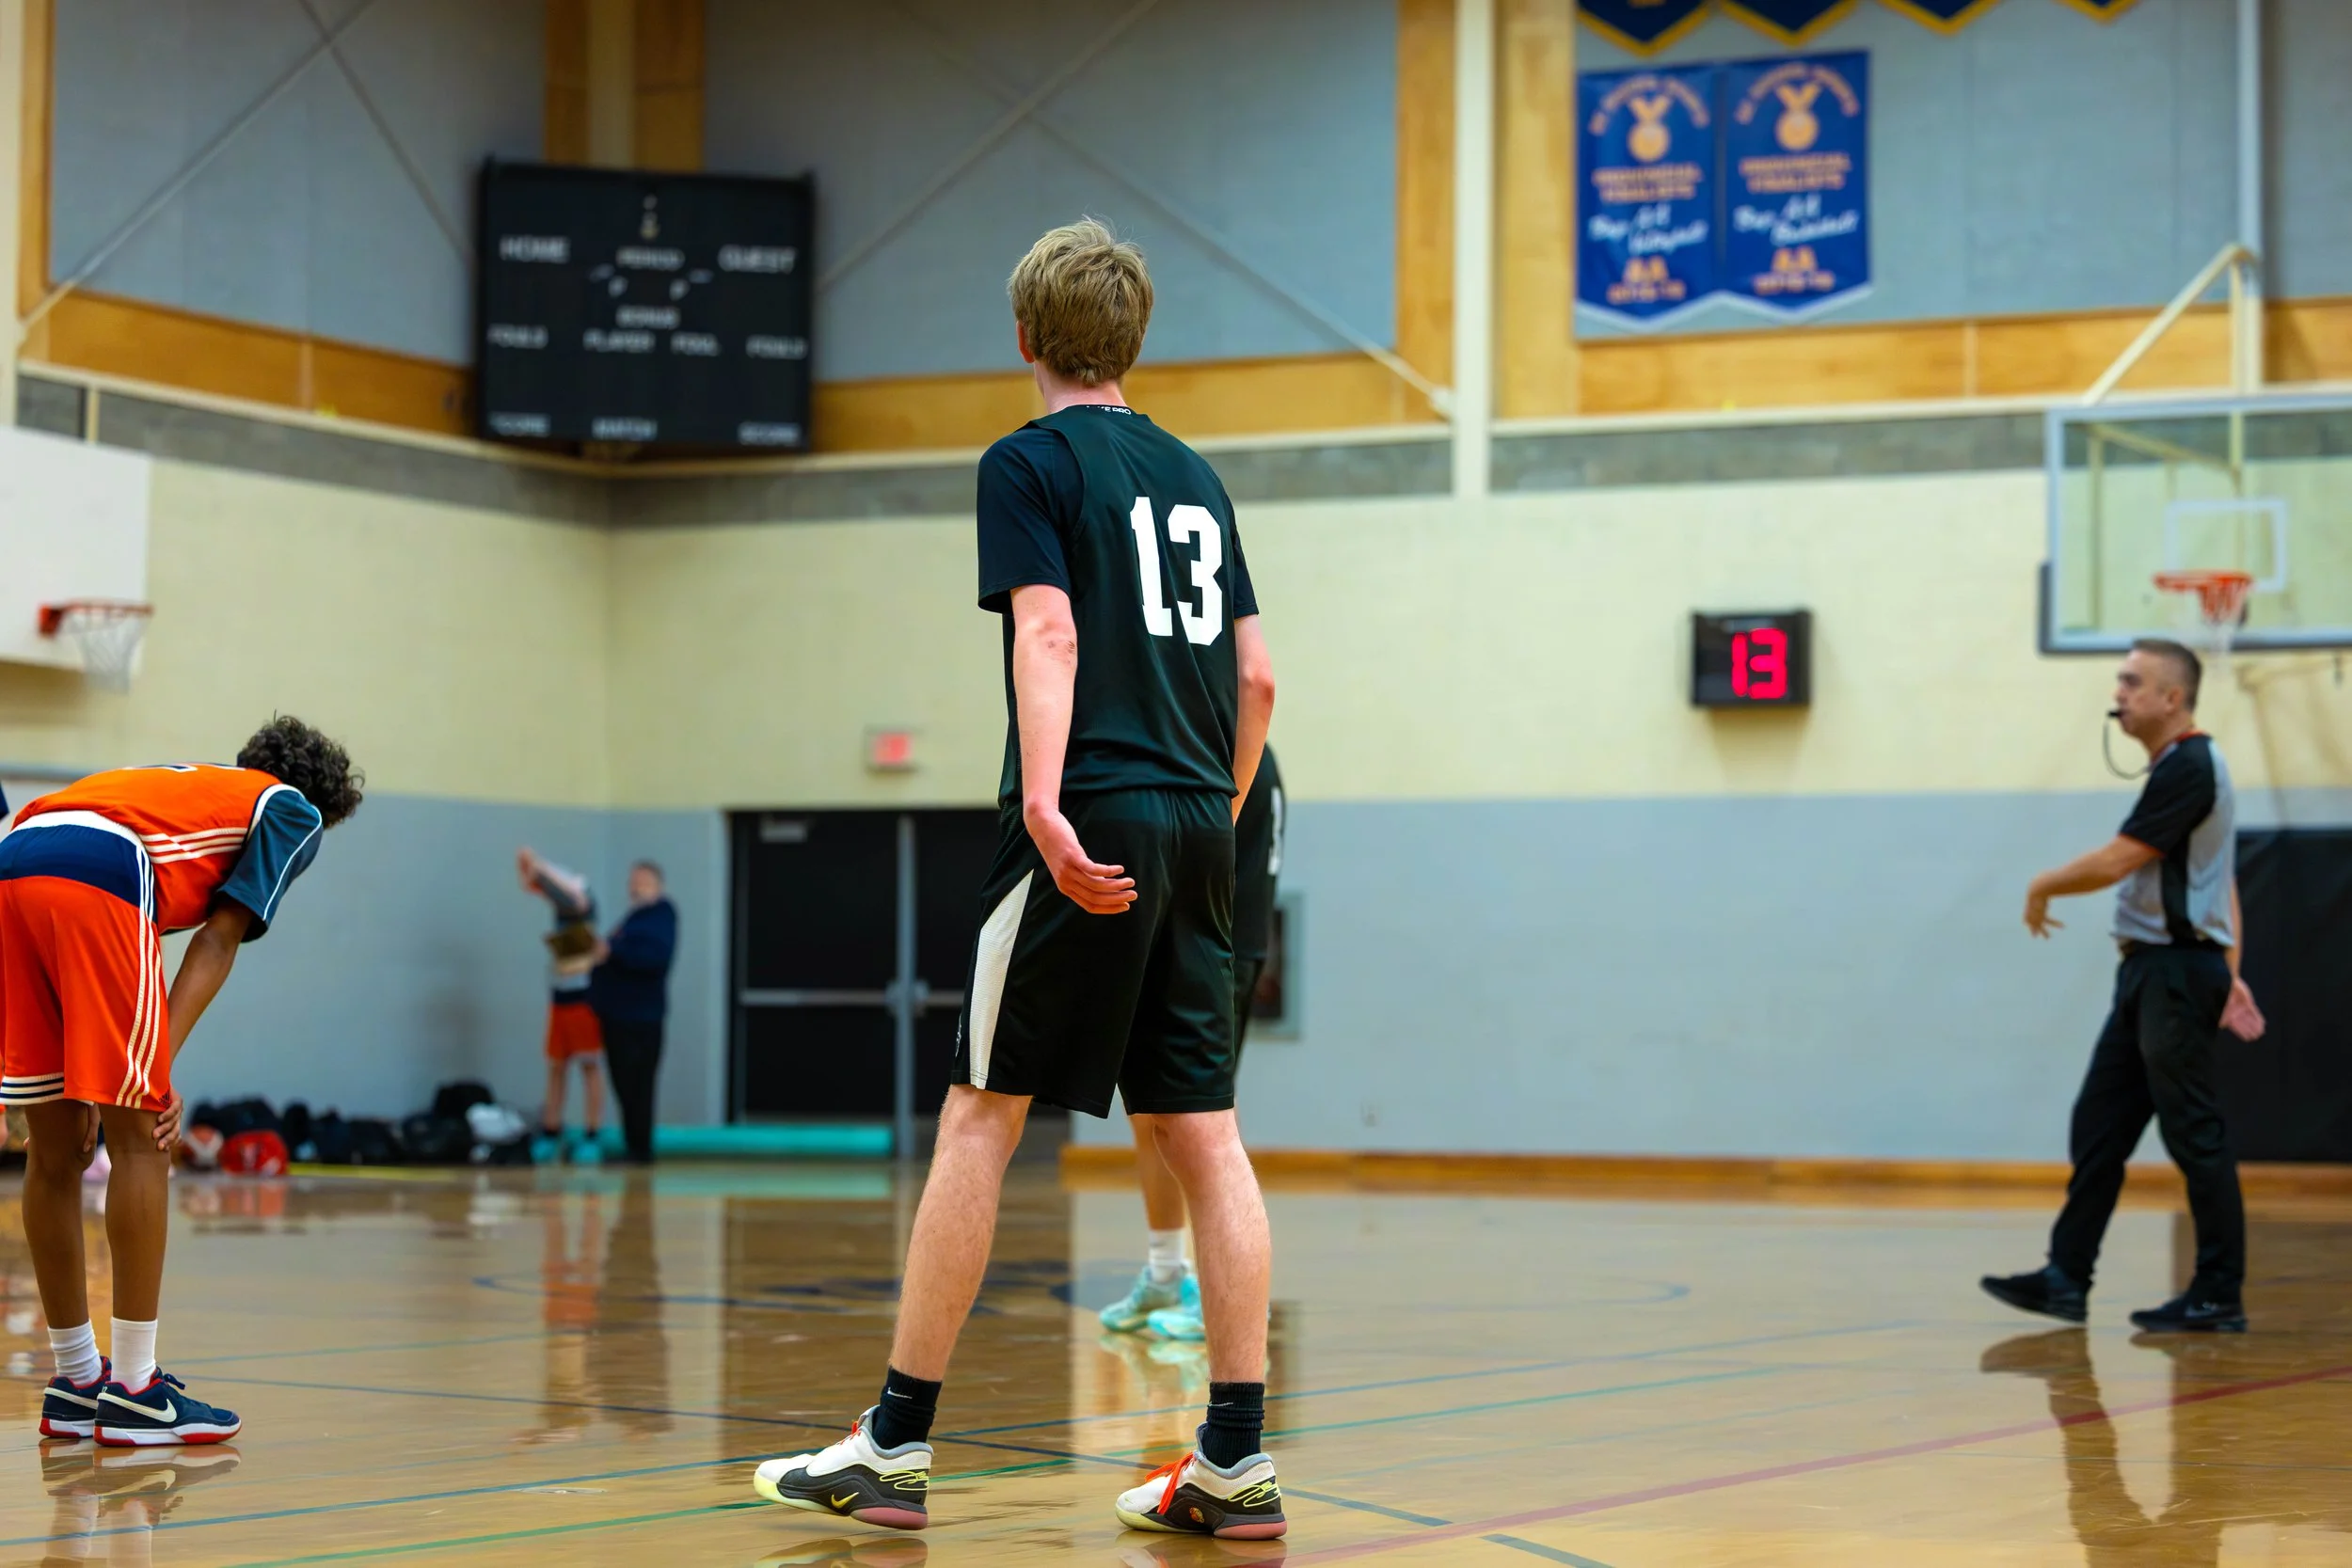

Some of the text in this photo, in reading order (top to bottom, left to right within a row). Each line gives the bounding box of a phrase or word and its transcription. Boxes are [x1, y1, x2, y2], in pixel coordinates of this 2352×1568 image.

[501, 235, 569, 262] HOME
[718, 245, 796, 272] GUEST
[1130, 497, 1222, 646] 13
[1731, 627, 1788, 699] 13
